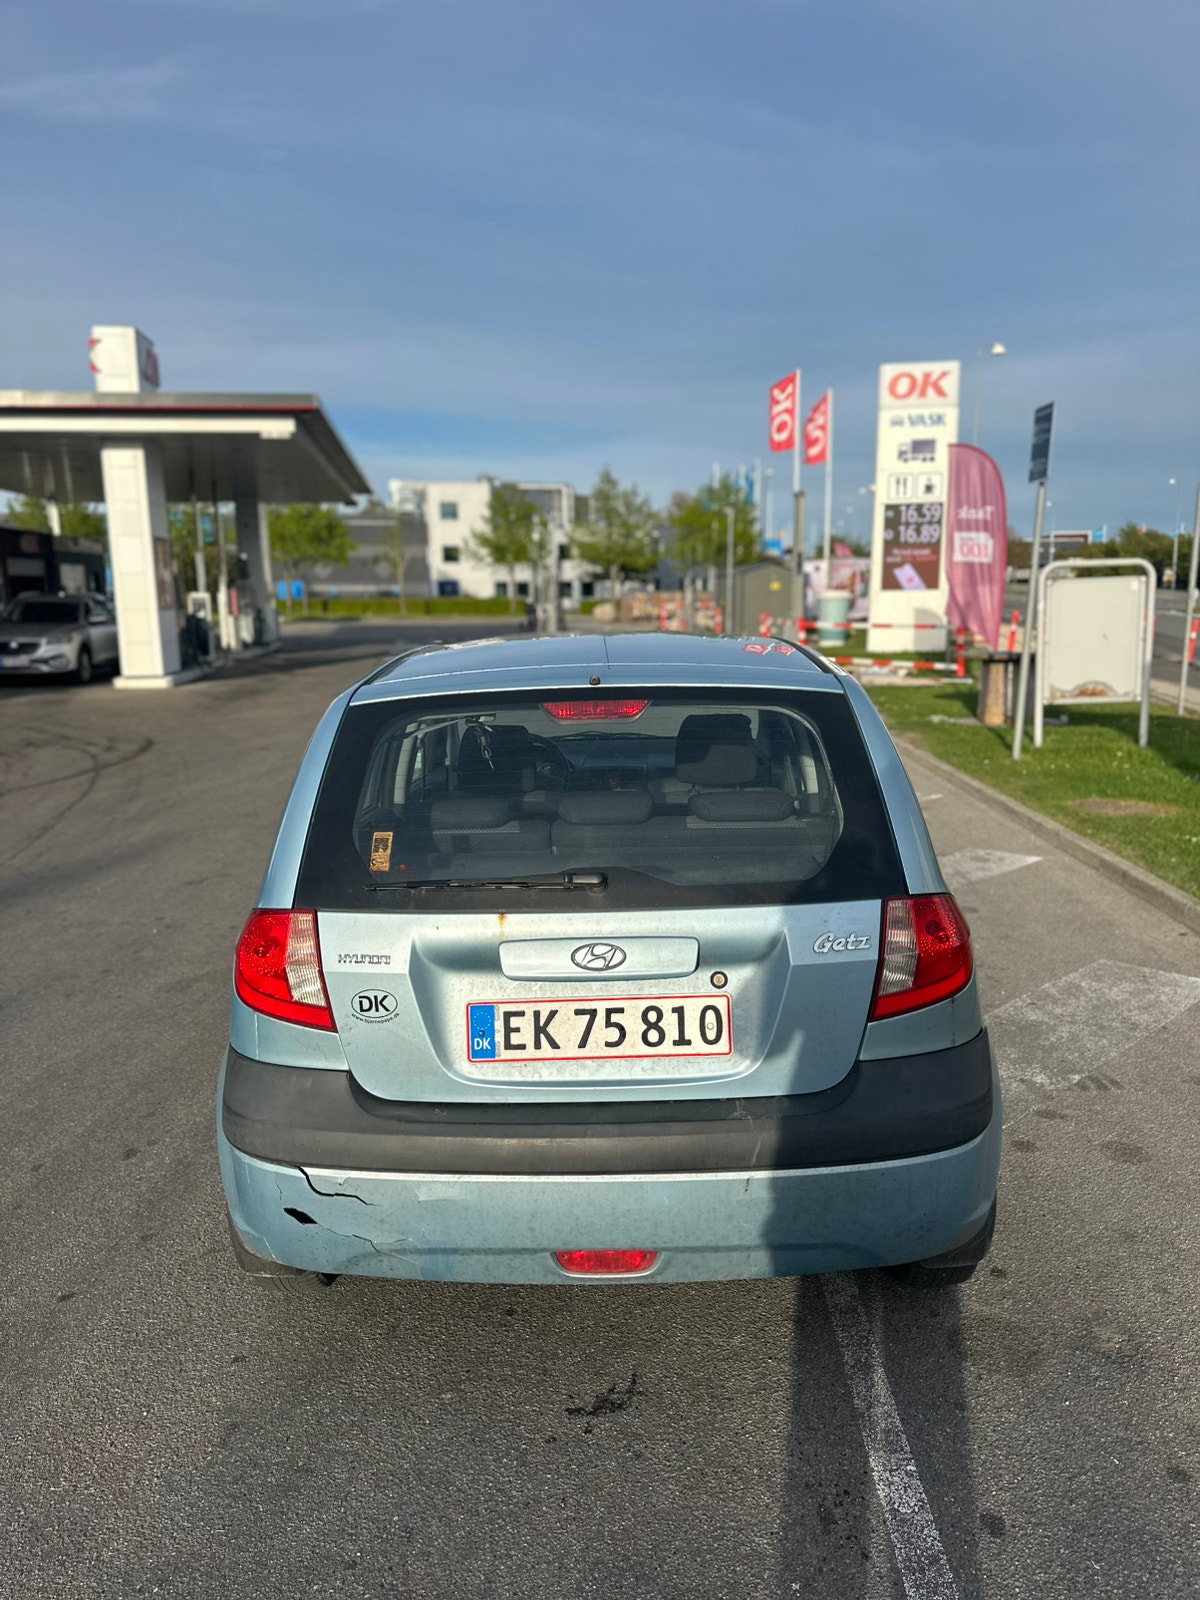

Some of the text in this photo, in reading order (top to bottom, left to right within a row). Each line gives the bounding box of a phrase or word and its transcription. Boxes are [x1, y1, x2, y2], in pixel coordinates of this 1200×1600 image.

[888, 370, 952, 400] OK
[770, 383, 793, 442] OK
[908, 413, 947, 428] VASK
[899, 504, 942, 524] 16.59
[898, 524, 941, 544] 16.89
[813, 932, 871, 954] Getz
[338, 953, 391, 965] HYUNDAI
[358, 994, 391, 1013] DK
[503, 1004, 724, 1051] EK 75 810
[474, 1037, 491, 1051] DK
